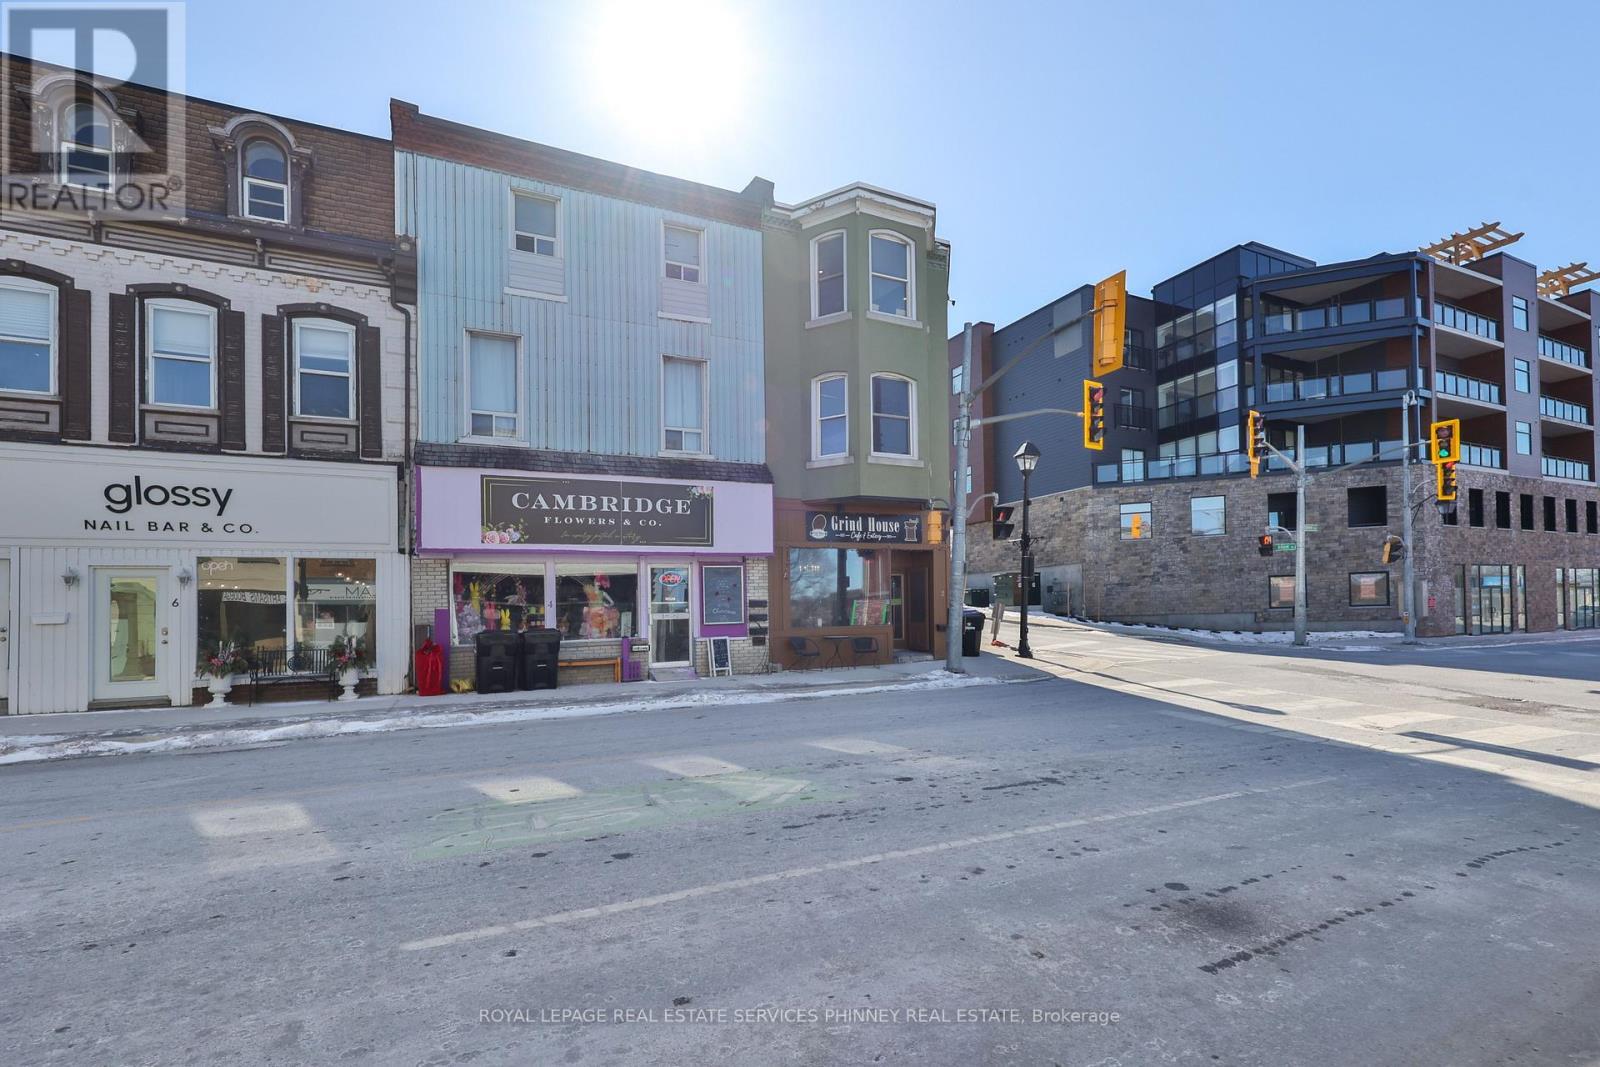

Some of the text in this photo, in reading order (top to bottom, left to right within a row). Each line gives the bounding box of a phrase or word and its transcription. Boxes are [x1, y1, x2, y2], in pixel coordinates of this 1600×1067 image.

[104, 475, 233, 516] glossy
[511, 492, 691, 515] CAMBRIDGE
[84, 519, 259, 534] NAIL BAR & CO.
[544, 516, 616, 526] FLOWERS
[639, 519, 662, 527] CO.
[831, 515, 899, 532] Grind House
[171, 597, 179, 607] 6
